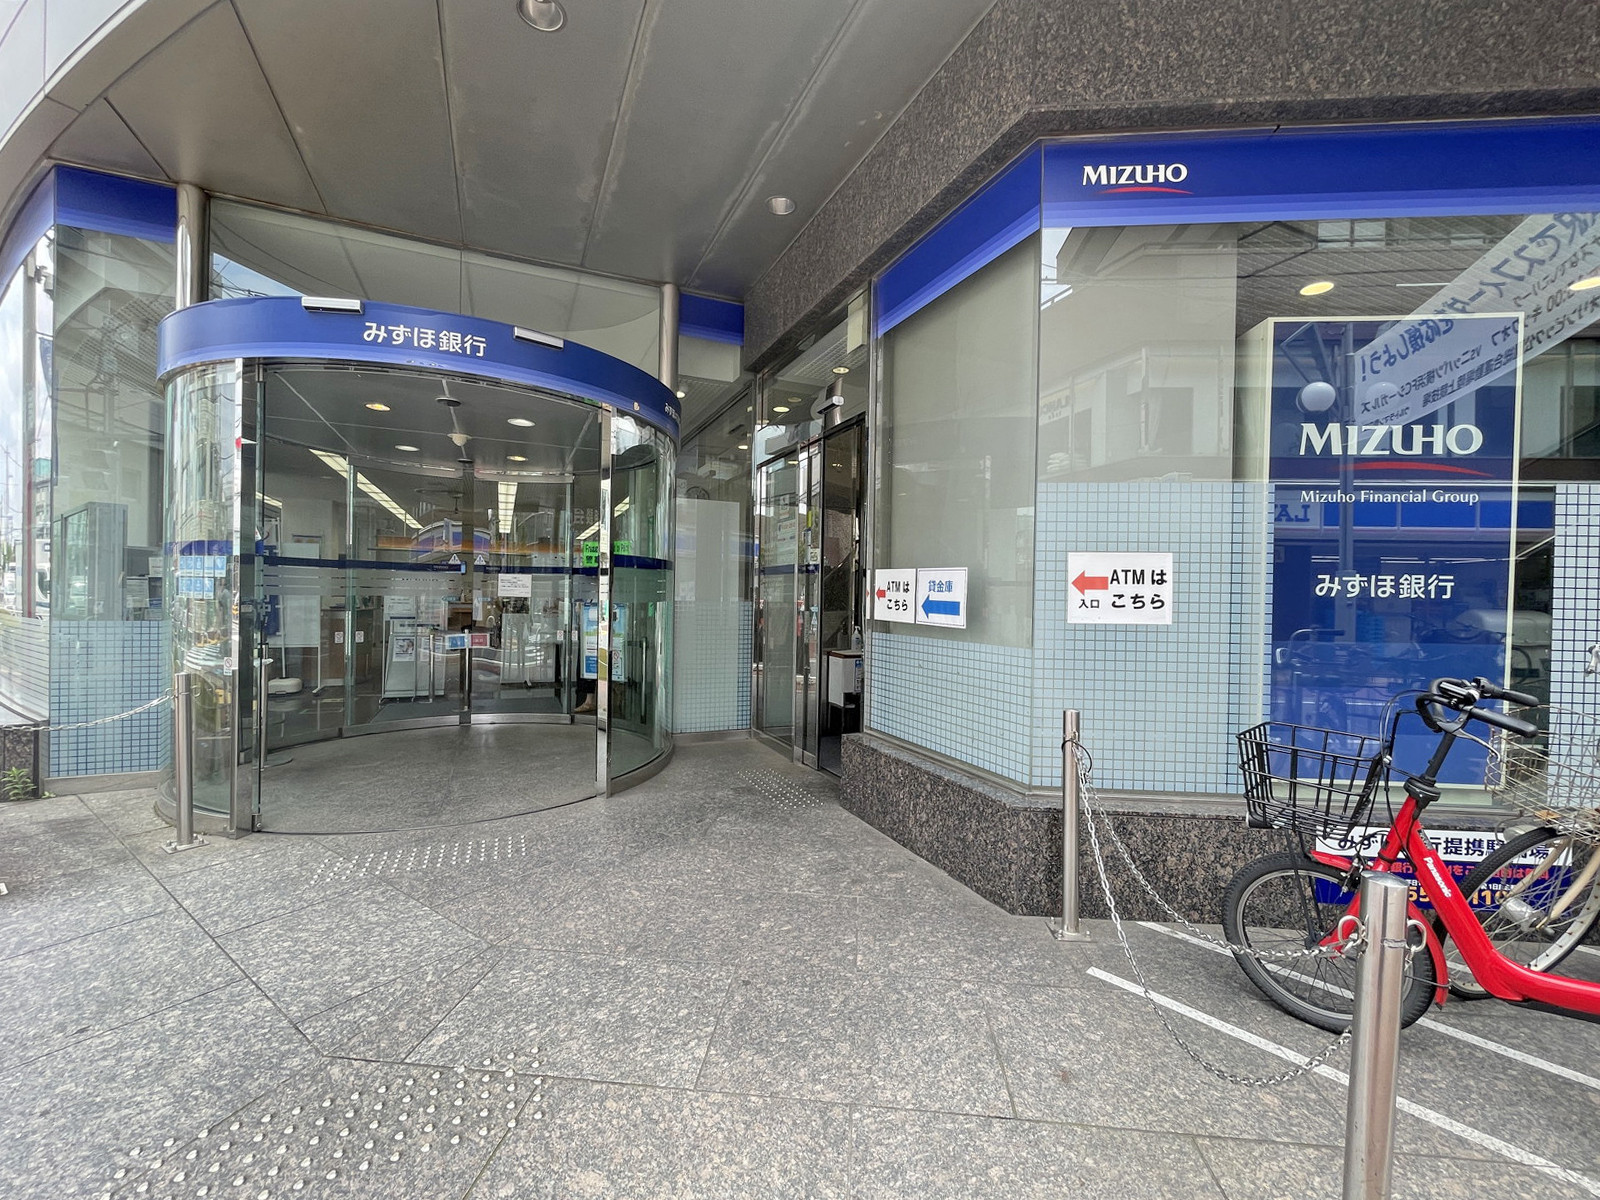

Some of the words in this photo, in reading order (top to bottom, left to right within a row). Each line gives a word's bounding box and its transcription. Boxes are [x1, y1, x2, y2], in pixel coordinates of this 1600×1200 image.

[1082, 163, 1188, 186] MIZUHO
[363, 322, 487, 357] みずほ銀行
[1299, 422, 1484, 456] MIZUHO
[1300, 490, 1355, 503] Mizuho
[1360, 489, 1427, 503] Financial
[1432, 490, 1479, 506] Group
[928, 580, 953, 593] 貸金庫
[1315, 574, 1455, 599] みずほ銀行
[887, 599, 908, 611] こちら
[1078, 599, 1100, 609] 入口
[1111, 593, 1165, 609] こちら
[1423, 856, 1452, 898] Panasonic
